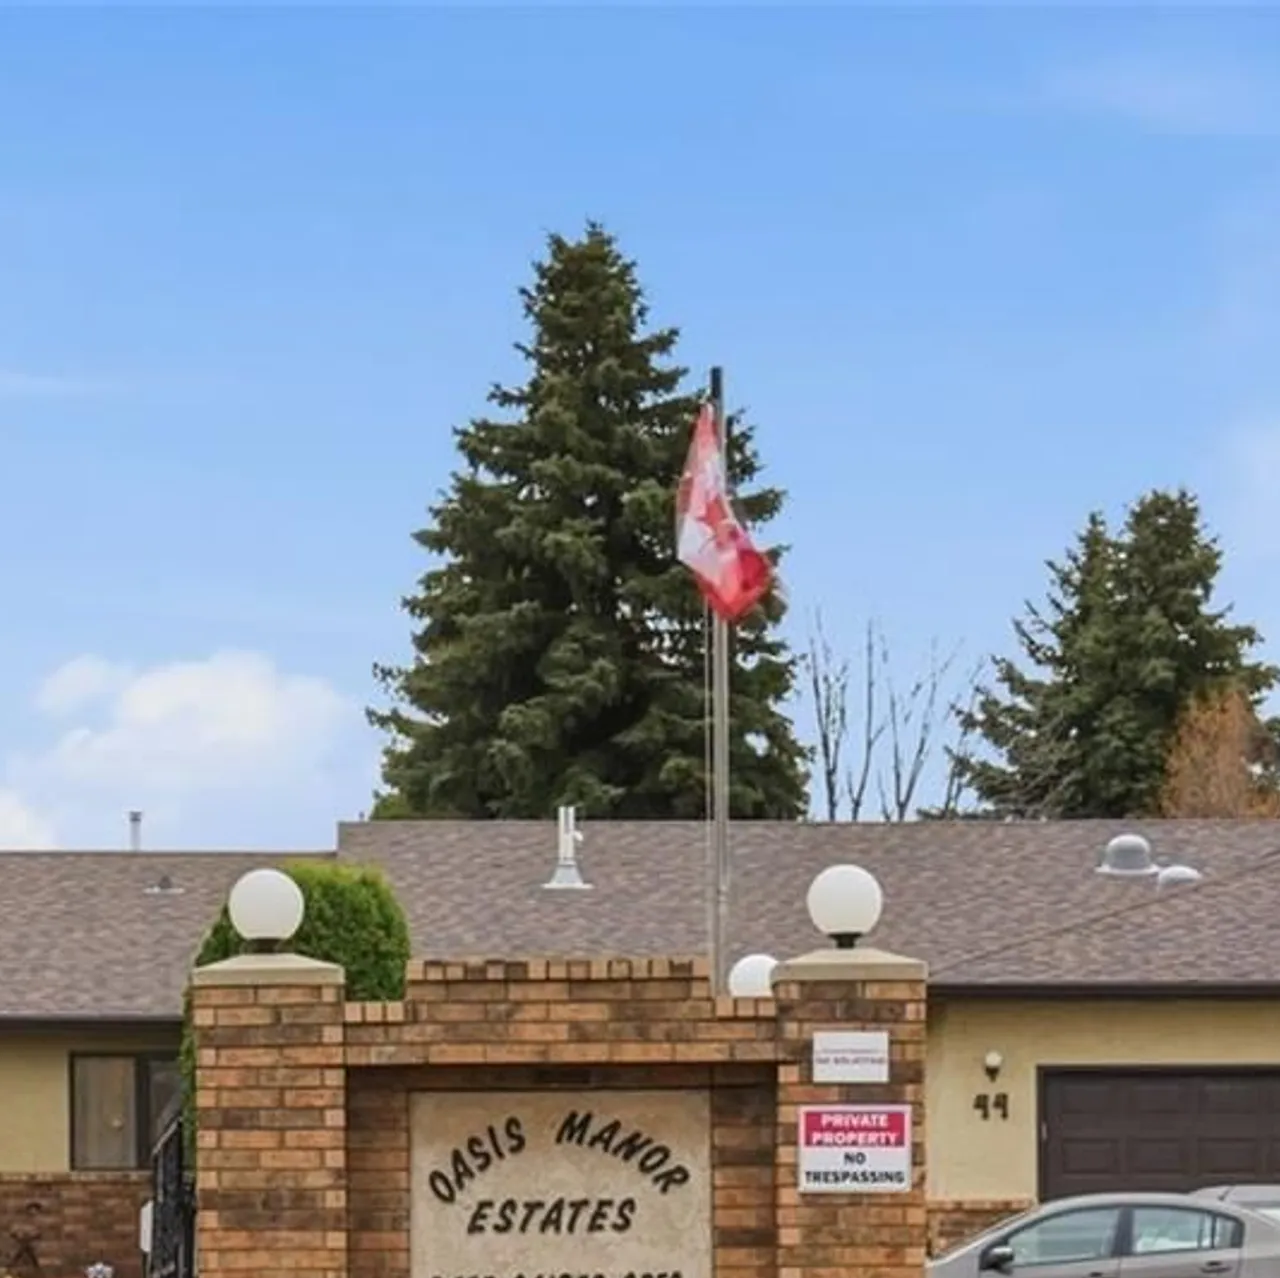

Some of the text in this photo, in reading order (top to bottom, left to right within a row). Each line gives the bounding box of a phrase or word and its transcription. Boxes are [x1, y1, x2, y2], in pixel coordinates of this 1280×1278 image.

[821, 1112, 889, 1128] PRIVATE
[812, 1131, 899, 1146] PROPERTY
[428, 1110, 691, 1205] OASIS MANOR
[843, 1151, 867, 1166] NO
[805, 1170, 906, 1184] TRESPASSING
[467, 1197, 637, 1235] ESTATES
